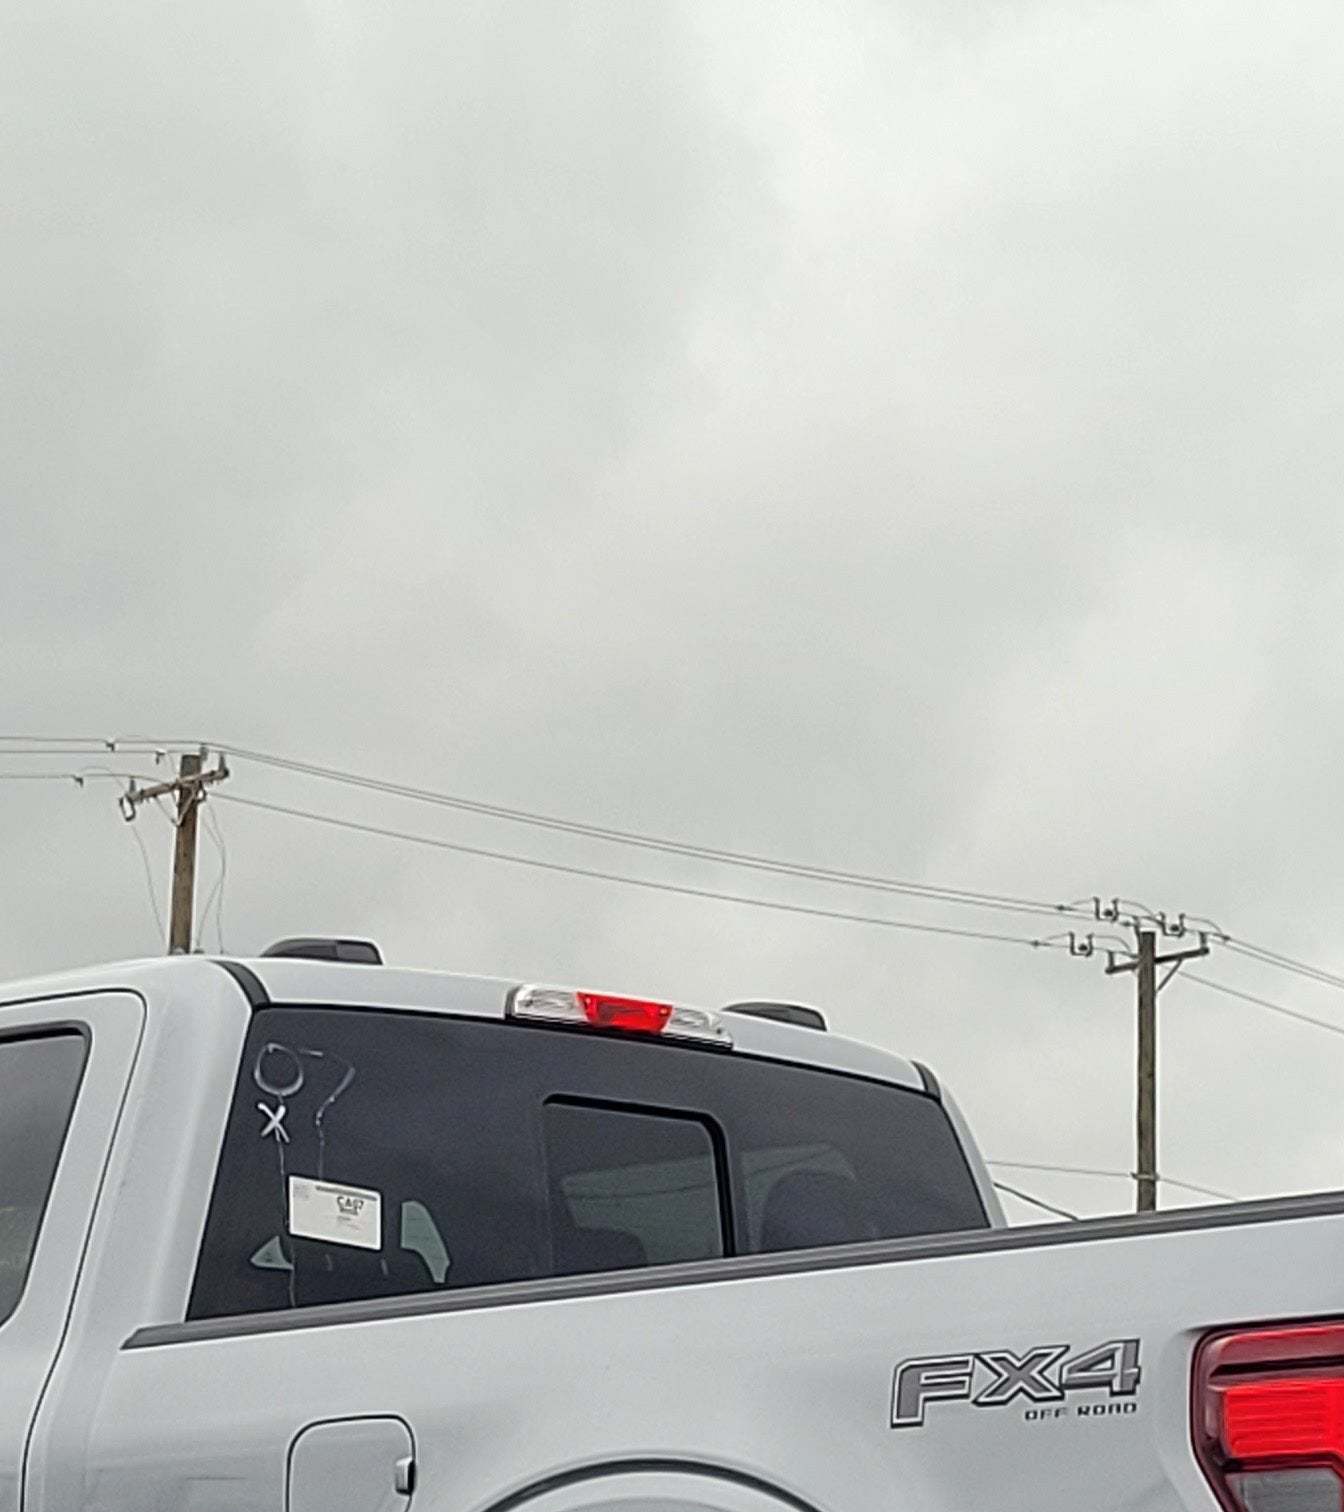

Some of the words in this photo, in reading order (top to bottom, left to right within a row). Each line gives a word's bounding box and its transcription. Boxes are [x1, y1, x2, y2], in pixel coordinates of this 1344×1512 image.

[890, 1337, 1141, 1429] FX4
[1024, 1407, 1068, 1421] OFF
[1077, 1402, 1138, 1417] ROAD
